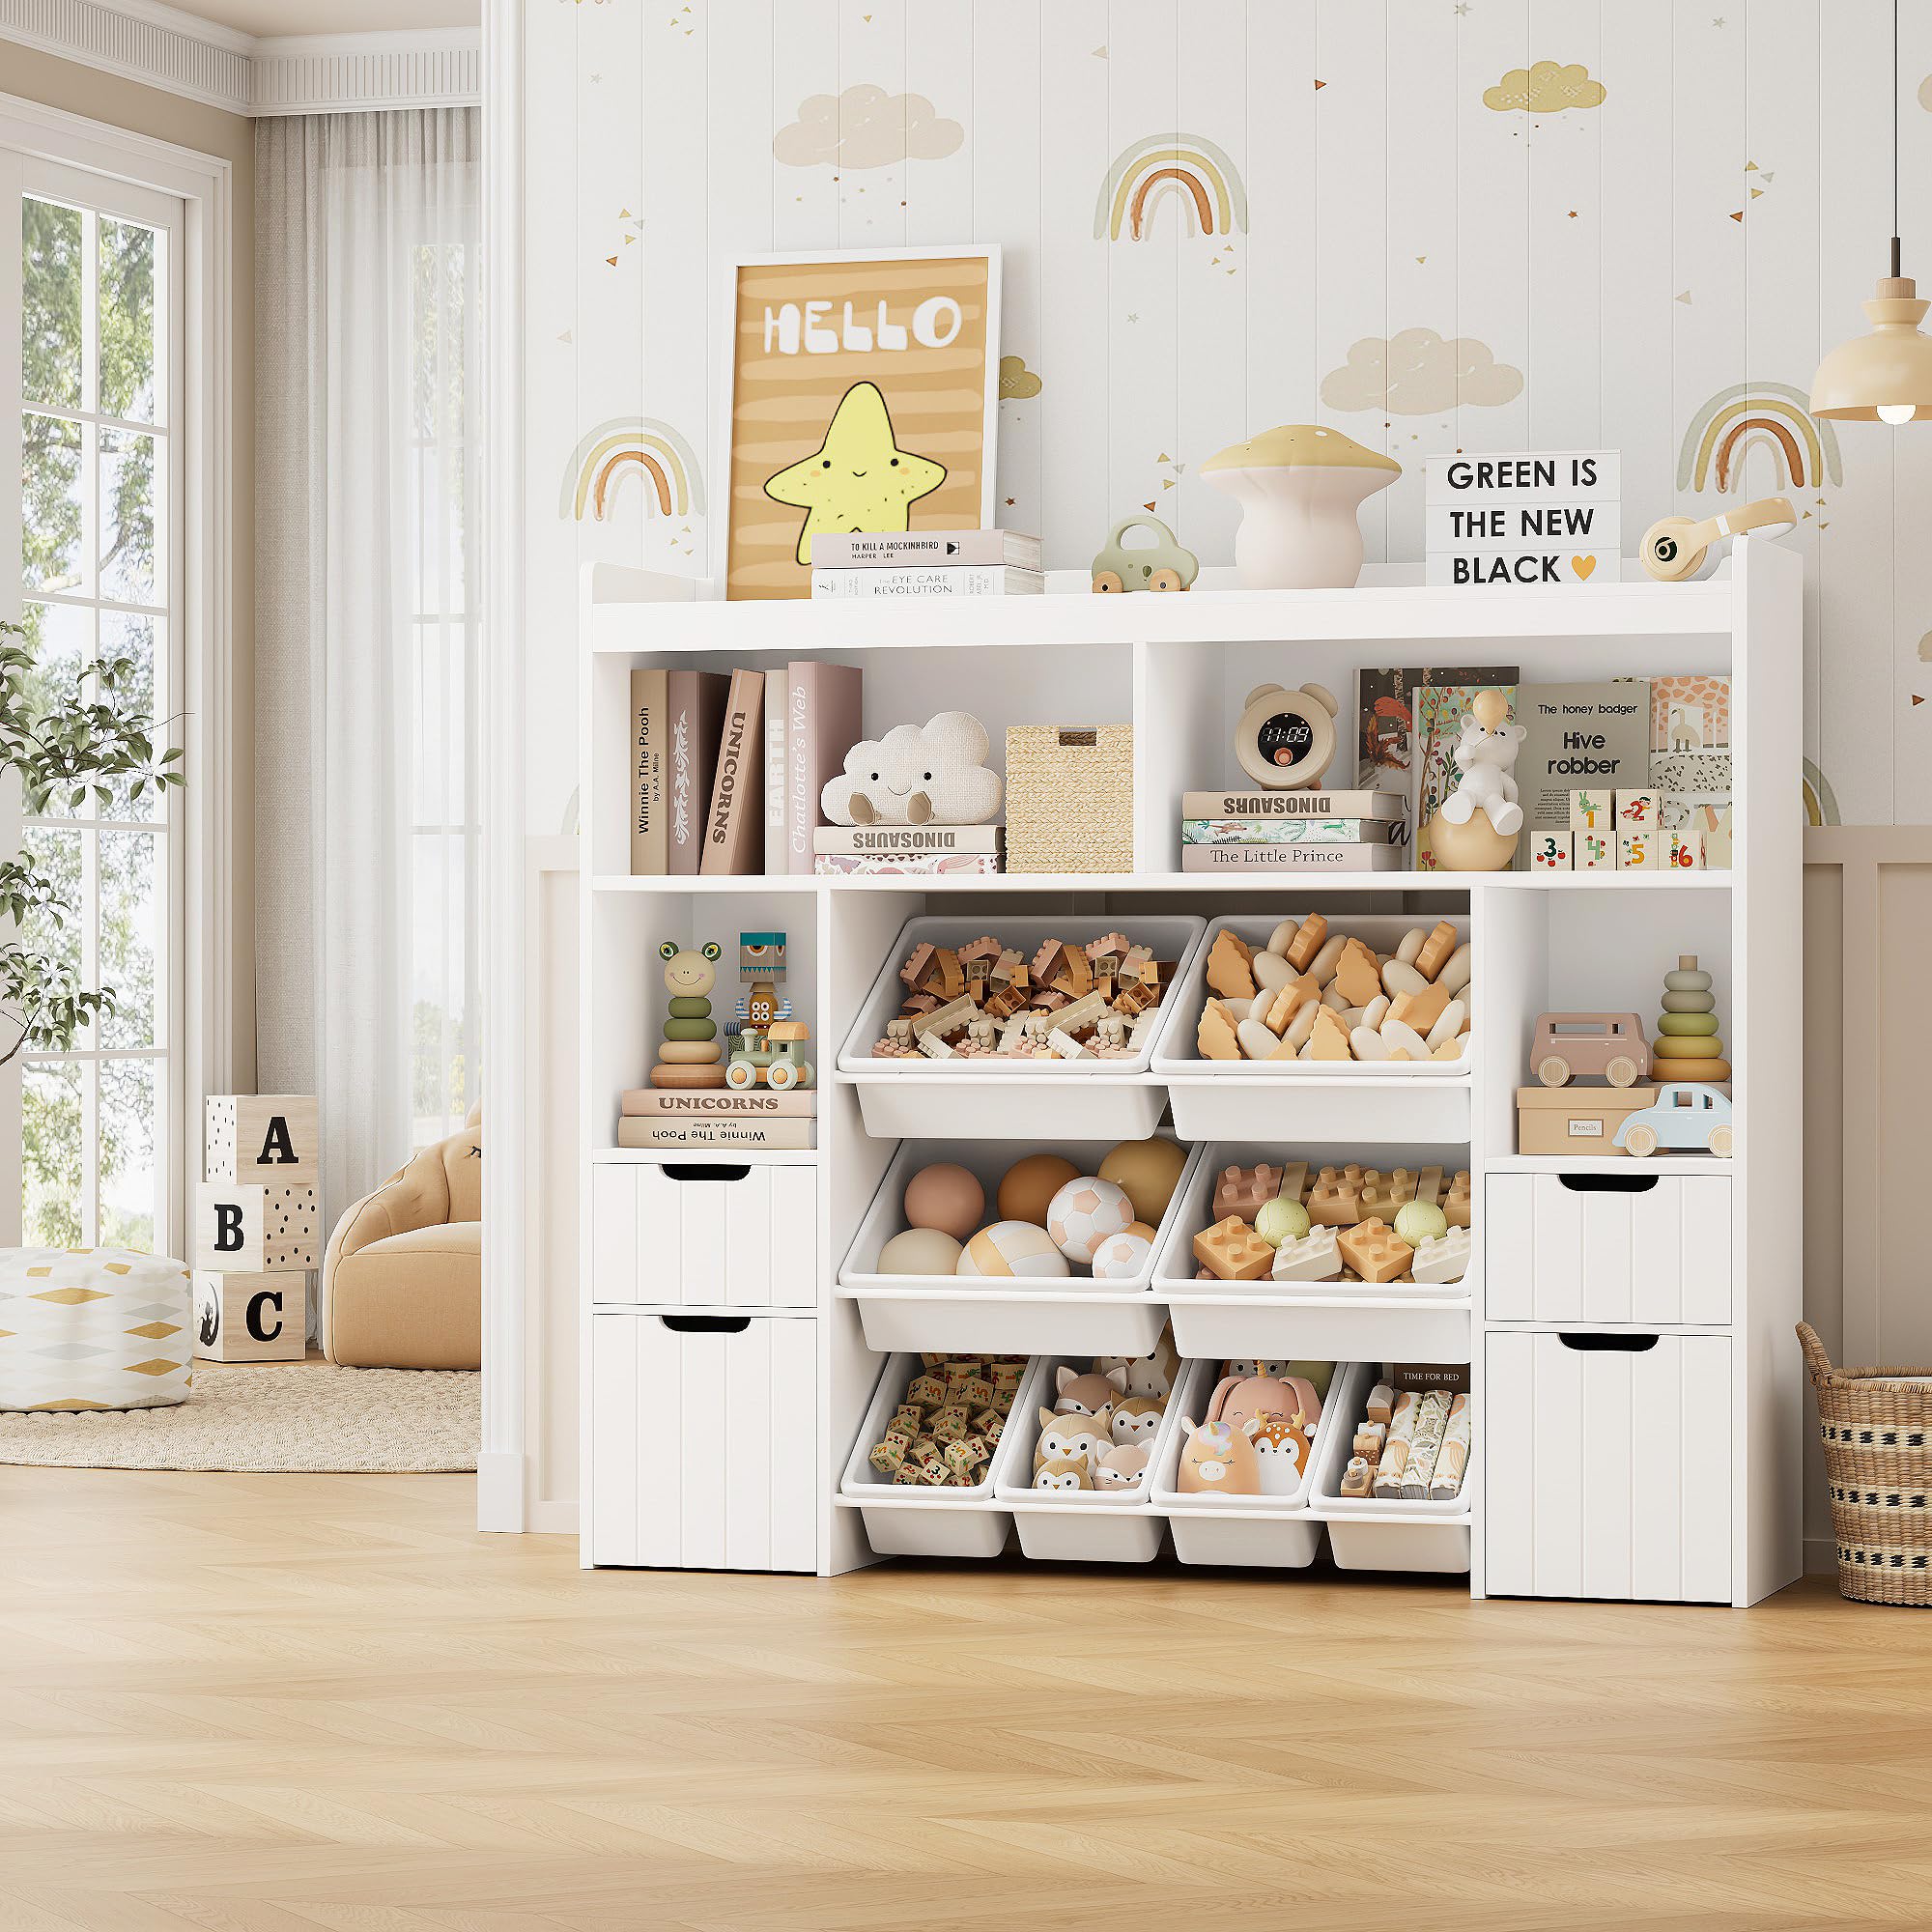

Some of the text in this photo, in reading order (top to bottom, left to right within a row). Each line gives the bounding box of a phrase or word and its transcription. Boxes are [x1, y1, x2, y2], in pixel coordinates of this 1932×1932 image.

[764, 296, 962, 355] HELLO
[1447, 459, 1598, 490] GREEN IS
[1450, 508, 1595, 538] THE NEW
[851, 543, 860, 552] TO
[862, 542, 878, 552] KILL
[879, 542, 885, 551] A
[892, 575, 913, 583] EYE
[917, 575, 948, 583] CARE
[1453, 555, 1561, 584] BLACK
[874, 584, 952, 595] REVOLUTION
[791, 686, 808, 731] Web
[1538, 704, 1638, 716] The honey badger
[1264, 726, 1310, 743] 11:09
[1563, 731, 1605, 750] Hive
[639, 707, 649, 835] Winnie The Pooh
[768, 719, 784, 827] EARTH
[1548, 756, 1620, 775] robber
[712, 711, 747, 845] UNICORNS
[652, 792, 660, 802] by
[1223, 797, 1331, 813] DINOSAURS
[1585, 810, 1595, 829] 1
[1629, 800, 1647, 822] 2
[852, 832, 955, 849] DINOSAURS
[1543, 838, 1556, 858] 3
[1587, 839, 1601, 861] 4
[1210, 849, 1344, 863] The Little Prince
[1631, 843, 1644, 865] 5
[1678, 844, 1693, 868] 6
[659, 1097, 779, 1110] UNICORNS
[652, 1130, 766, 1141] Winnie The Pooh
[1573, 1122, 1597, 1132] Pencils
[256, 1116, 299, 1165] A
[213, 1203, 244, 1252] B
[245, 1291, 283, 1342] C
[1404, 1372, 1460, 1381] TIME FOR BED
[930, 1464, 941, 1475] 3
